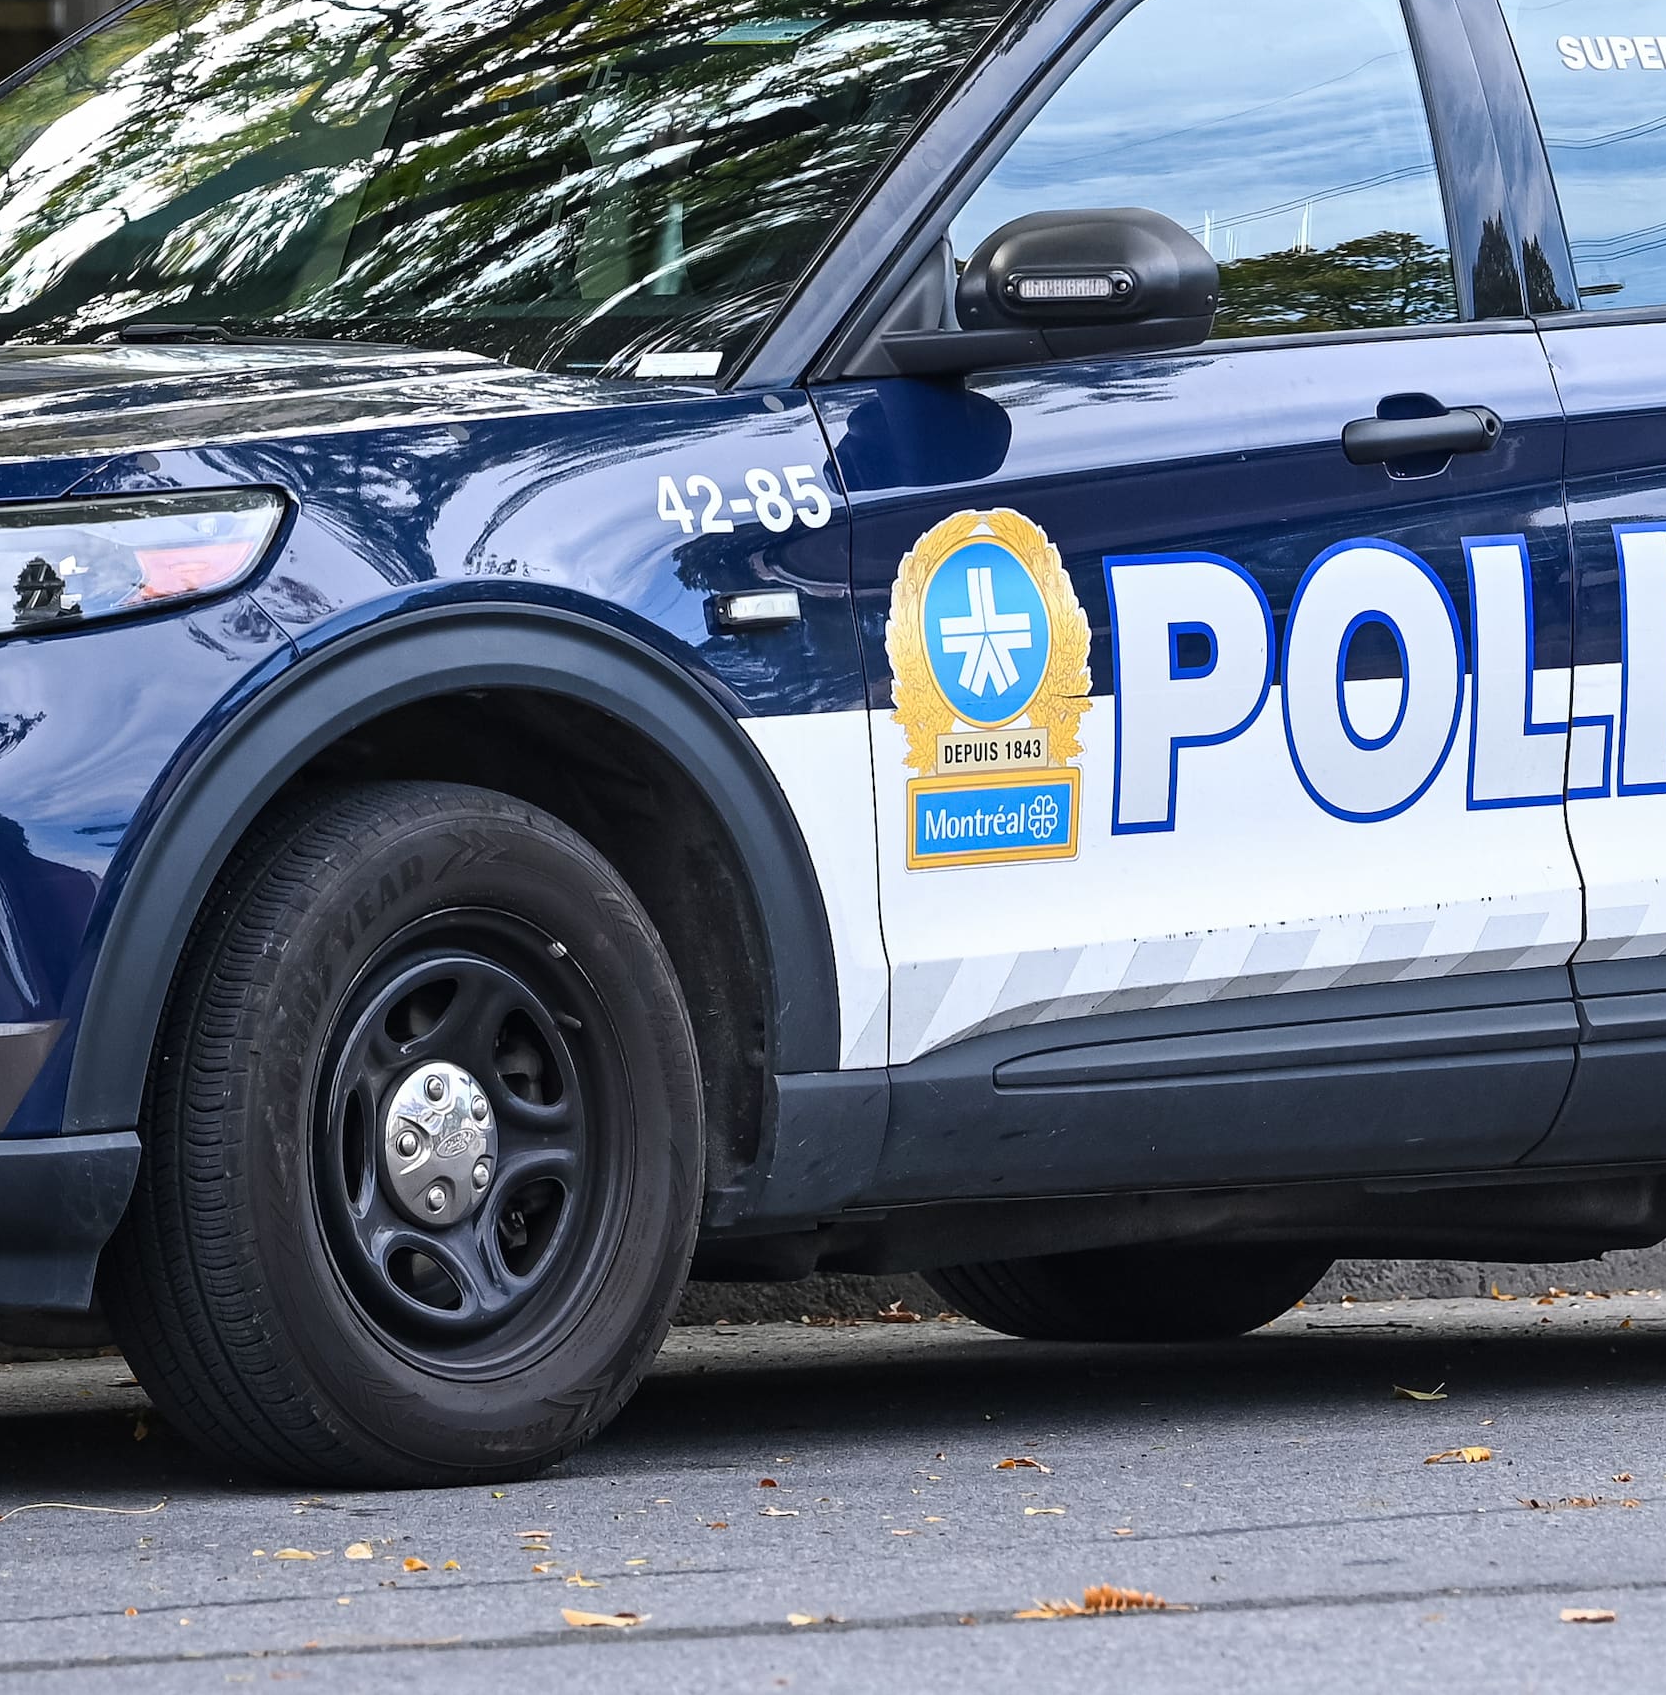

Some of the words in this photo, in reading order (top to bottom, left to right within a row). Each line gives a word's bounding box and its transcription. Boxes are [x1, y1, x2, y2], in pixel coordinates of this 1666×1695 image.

[656, 464, 832, 534] 42-85
[944, 741, 999, 764] DEPUIS
[1005, 739, 1041, 760] 1843
[925, 803, 1025, 841] Montréal
